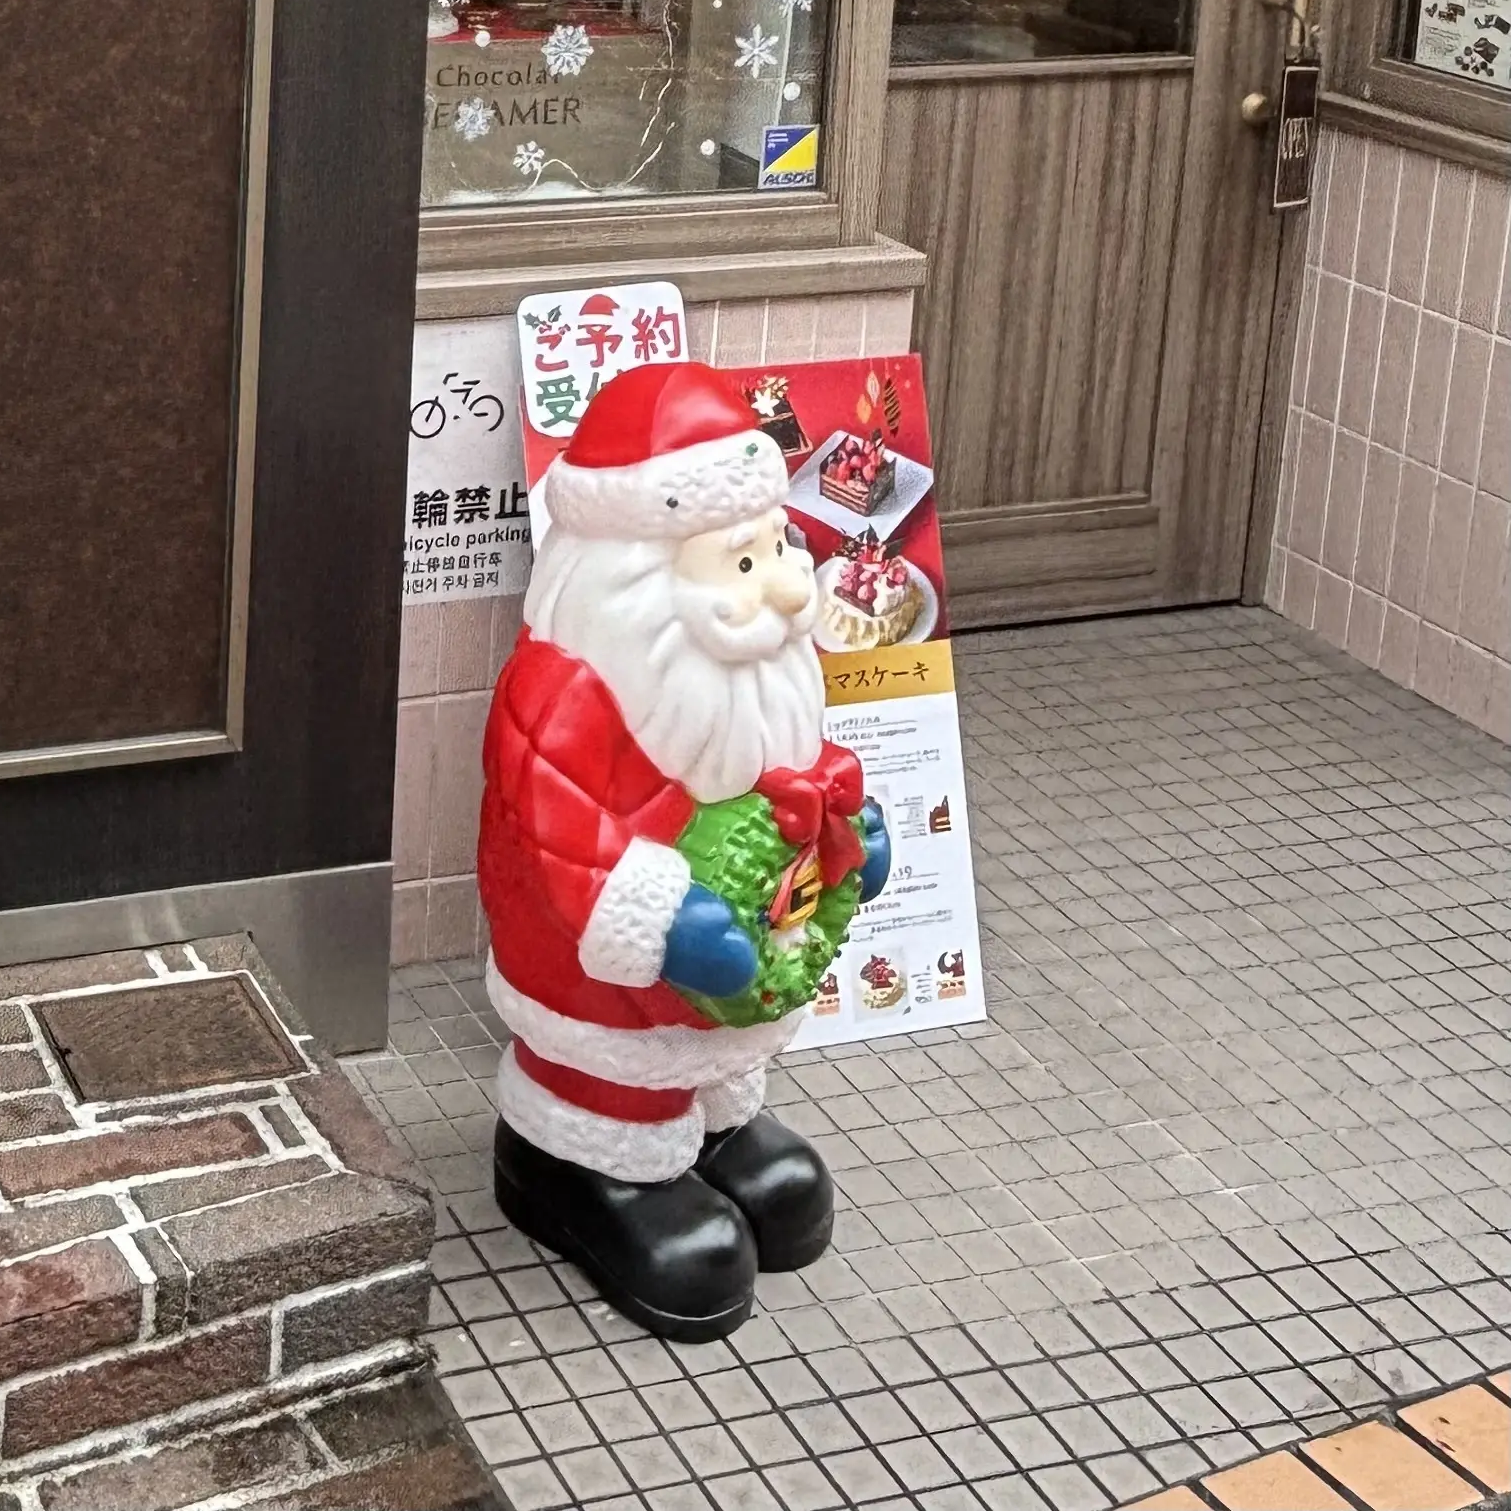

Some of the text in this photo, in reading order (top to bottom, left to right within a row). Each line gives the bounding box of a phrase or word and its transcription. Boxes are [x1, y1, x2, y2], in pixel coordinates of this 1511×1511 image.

[535, 306, 681, 372] ご予約
[403, 532, 460, 553] icycle
